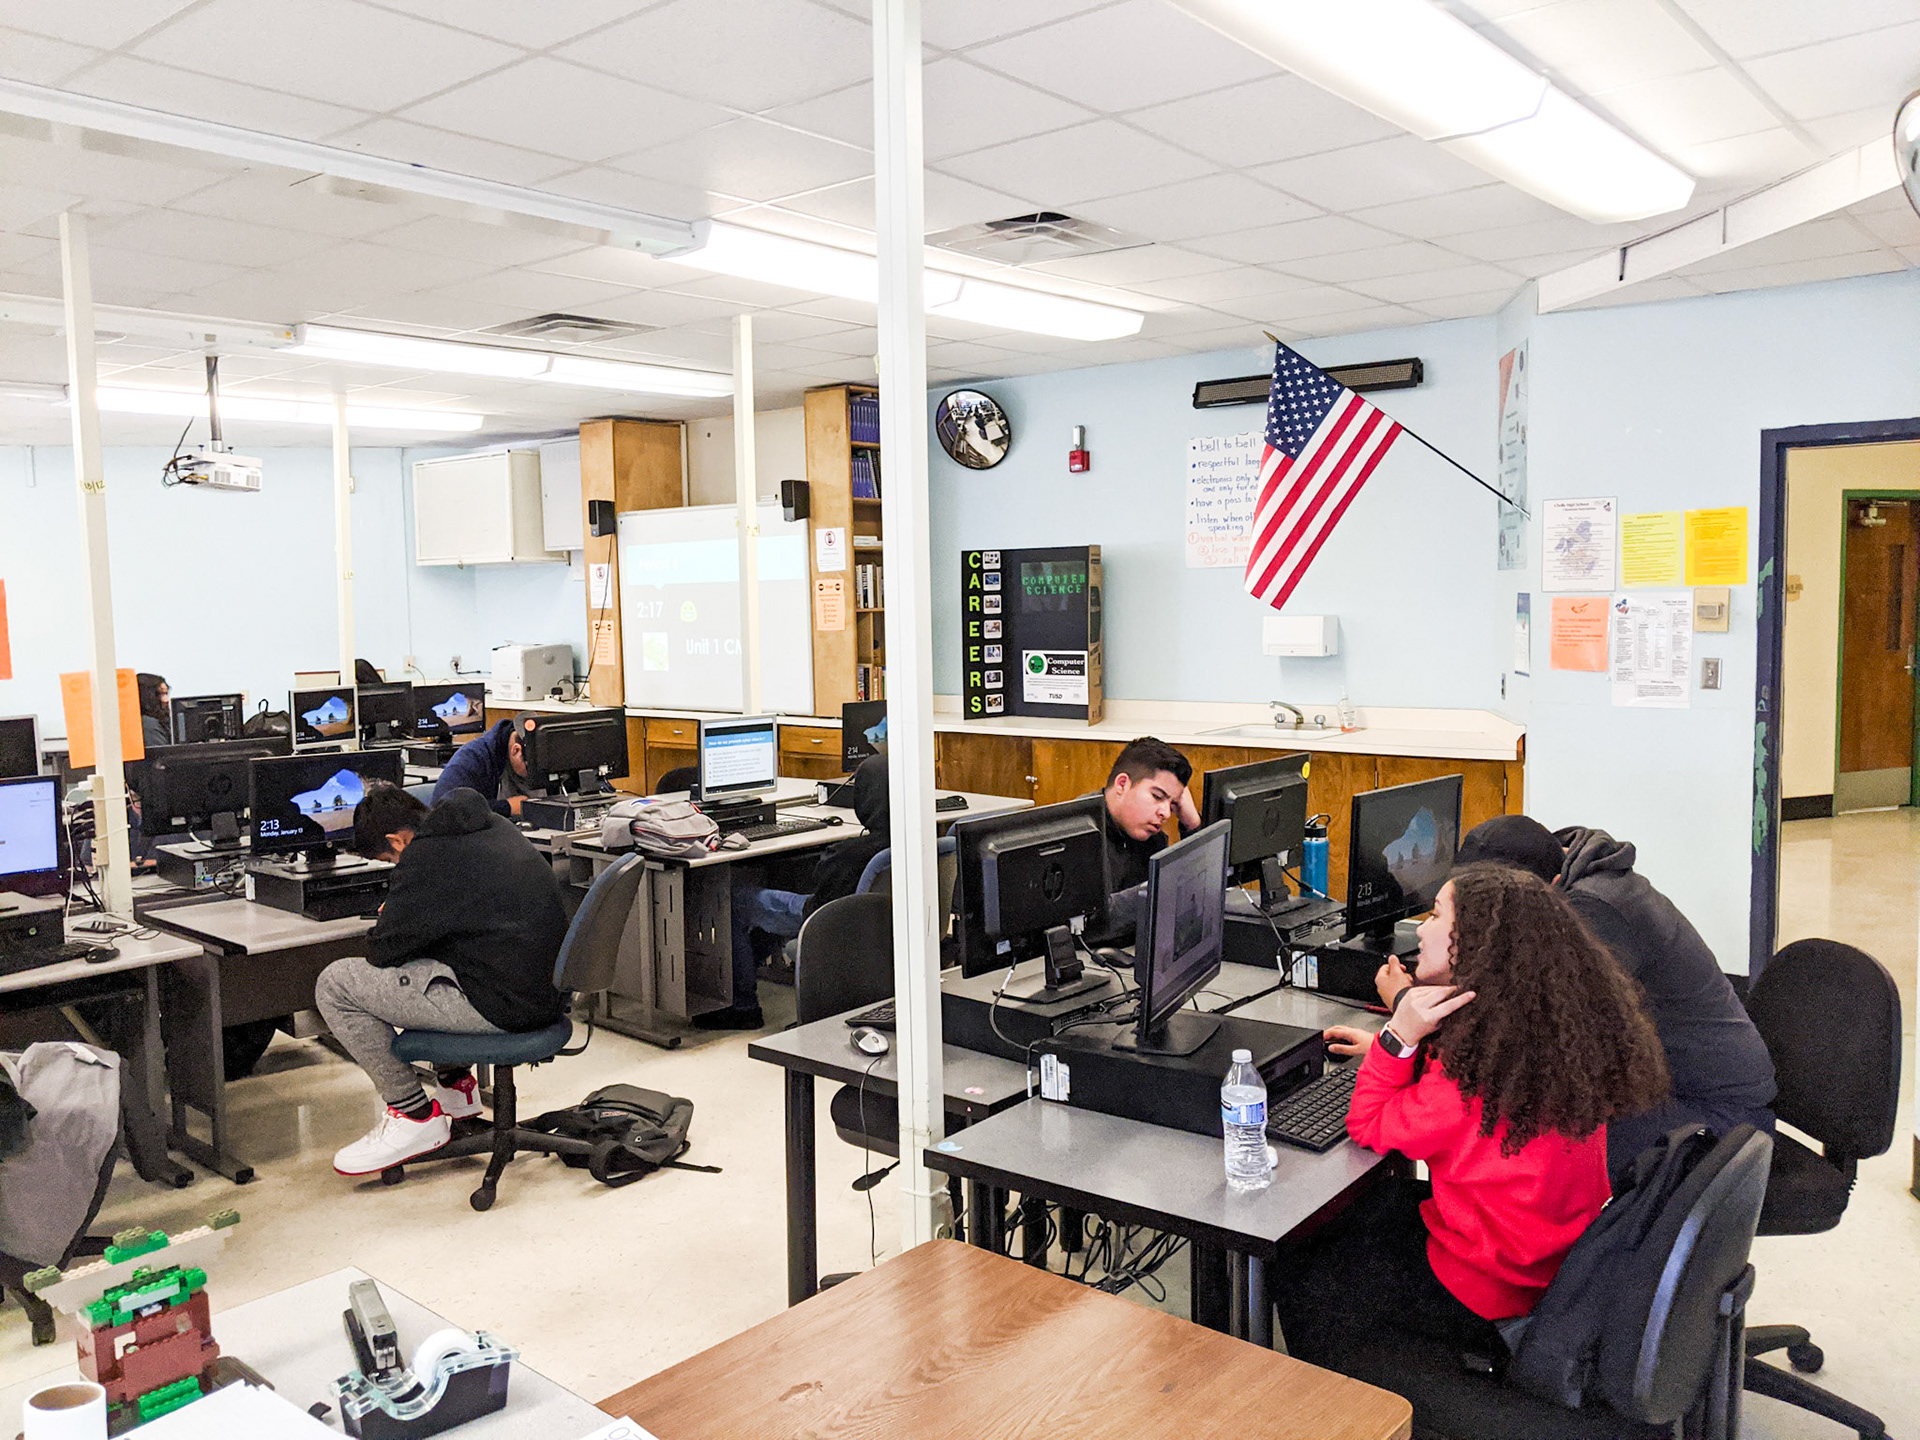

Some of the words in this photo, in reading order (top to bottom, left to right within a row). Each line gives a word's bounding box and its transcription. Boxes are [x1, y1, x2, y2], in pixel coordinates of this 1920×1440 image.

[1200, 440, 1220, 453] bell
[1224, 441, 1233, 450] to
[1236, 438, 1256, 448] bell
[1198, 457, 1239, 471] respectful
[1195, 497, 1213, 507] have
[1195, 513, 1219, 524] listen
[1223, 511, 1243, 523] when
[1207, 523, 1244, 536] speaking
[1021, 573, 1086, 586] COMPUTER
[1026, 584, 1082, 595] SCIENCE
[636, 601, 664, 619] 2:17
[968, 551, 982, 713] CAREERS
[685, 638, 710, 655] Unit
[713, 639, 720, 655] 1
[1047, 657, 1085, 668] Computer
[1051, 666, 1081, 675] Science
[260, 819, 280, 831] 2:13
[260, 830, 280, 838] Monday,
[1357, 881, 1373, 899] 2:13
